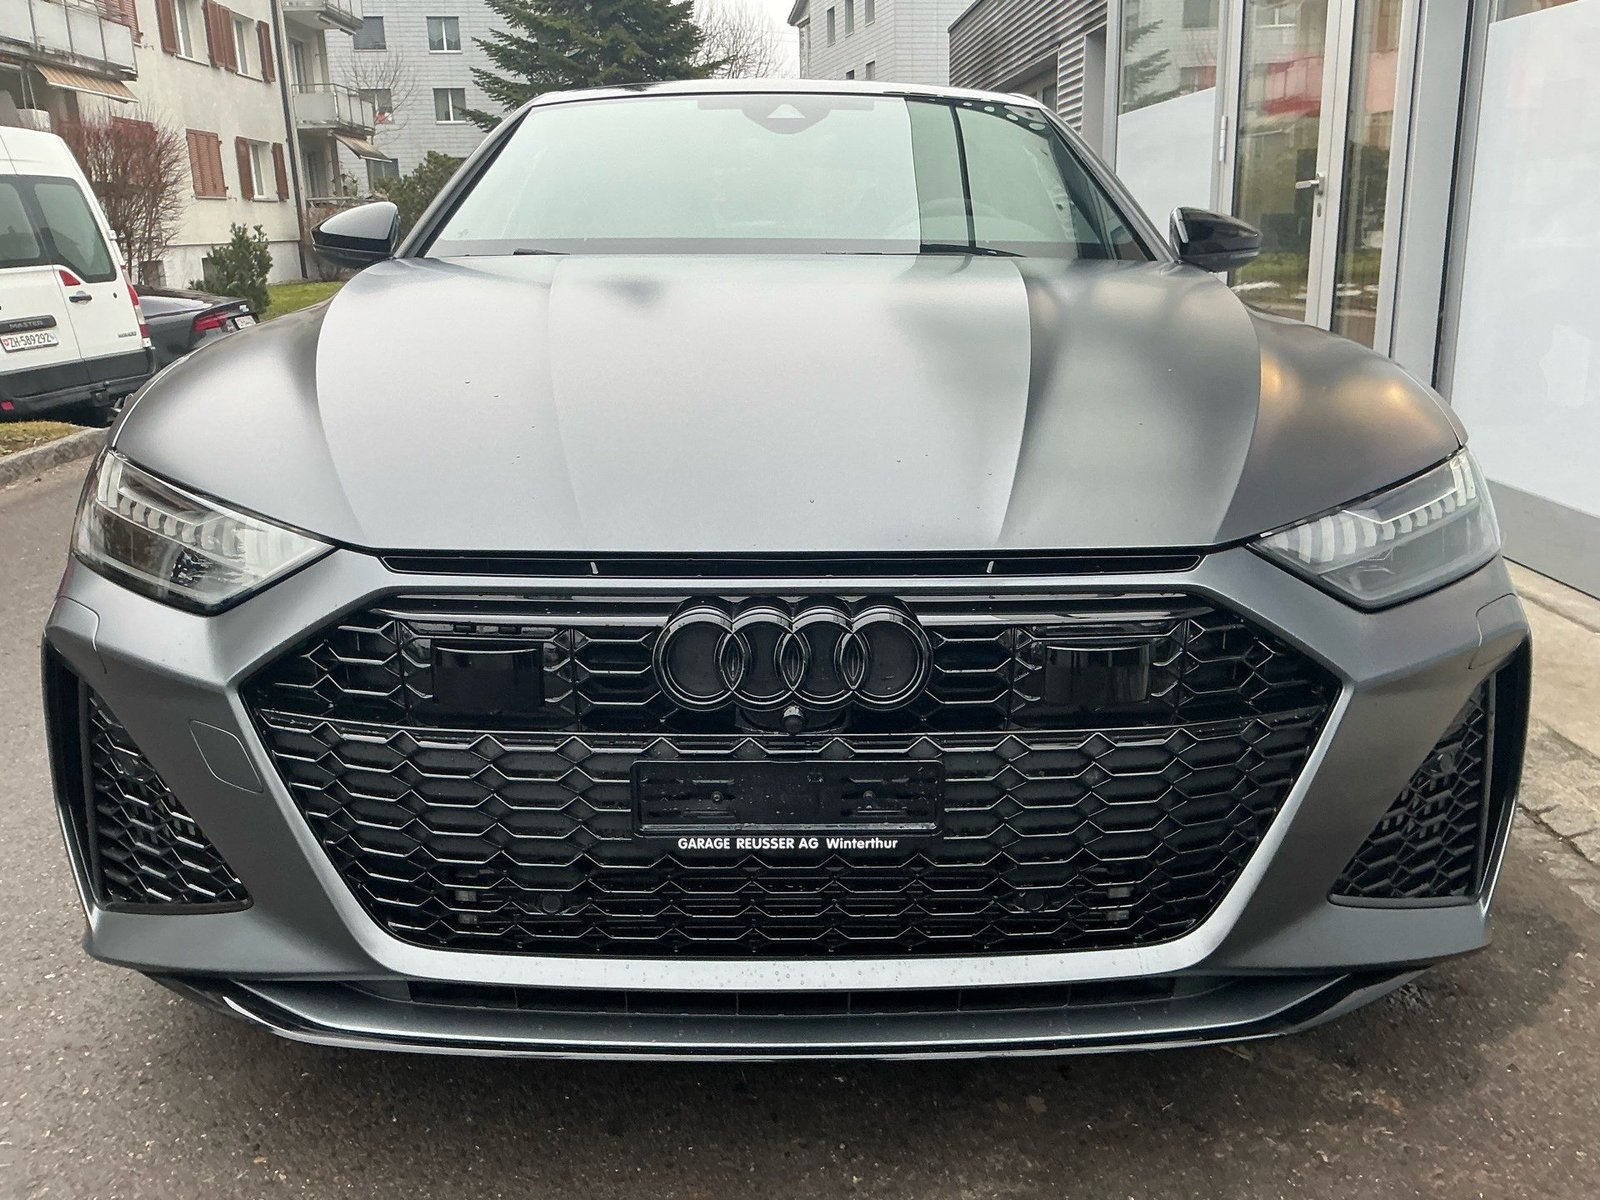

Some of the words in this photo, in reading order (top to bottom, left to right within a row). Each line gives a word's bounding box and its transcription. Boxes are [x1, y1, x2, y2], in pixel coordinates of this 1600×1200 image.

[10, 321, 43, 329] MASTER
[678, 837, 730, 849] GARAGE
[736, 837, 795, 849] REUSSER
[798, 837, 819, 849] AG
[826, 837, 898, 849] Winterthur
